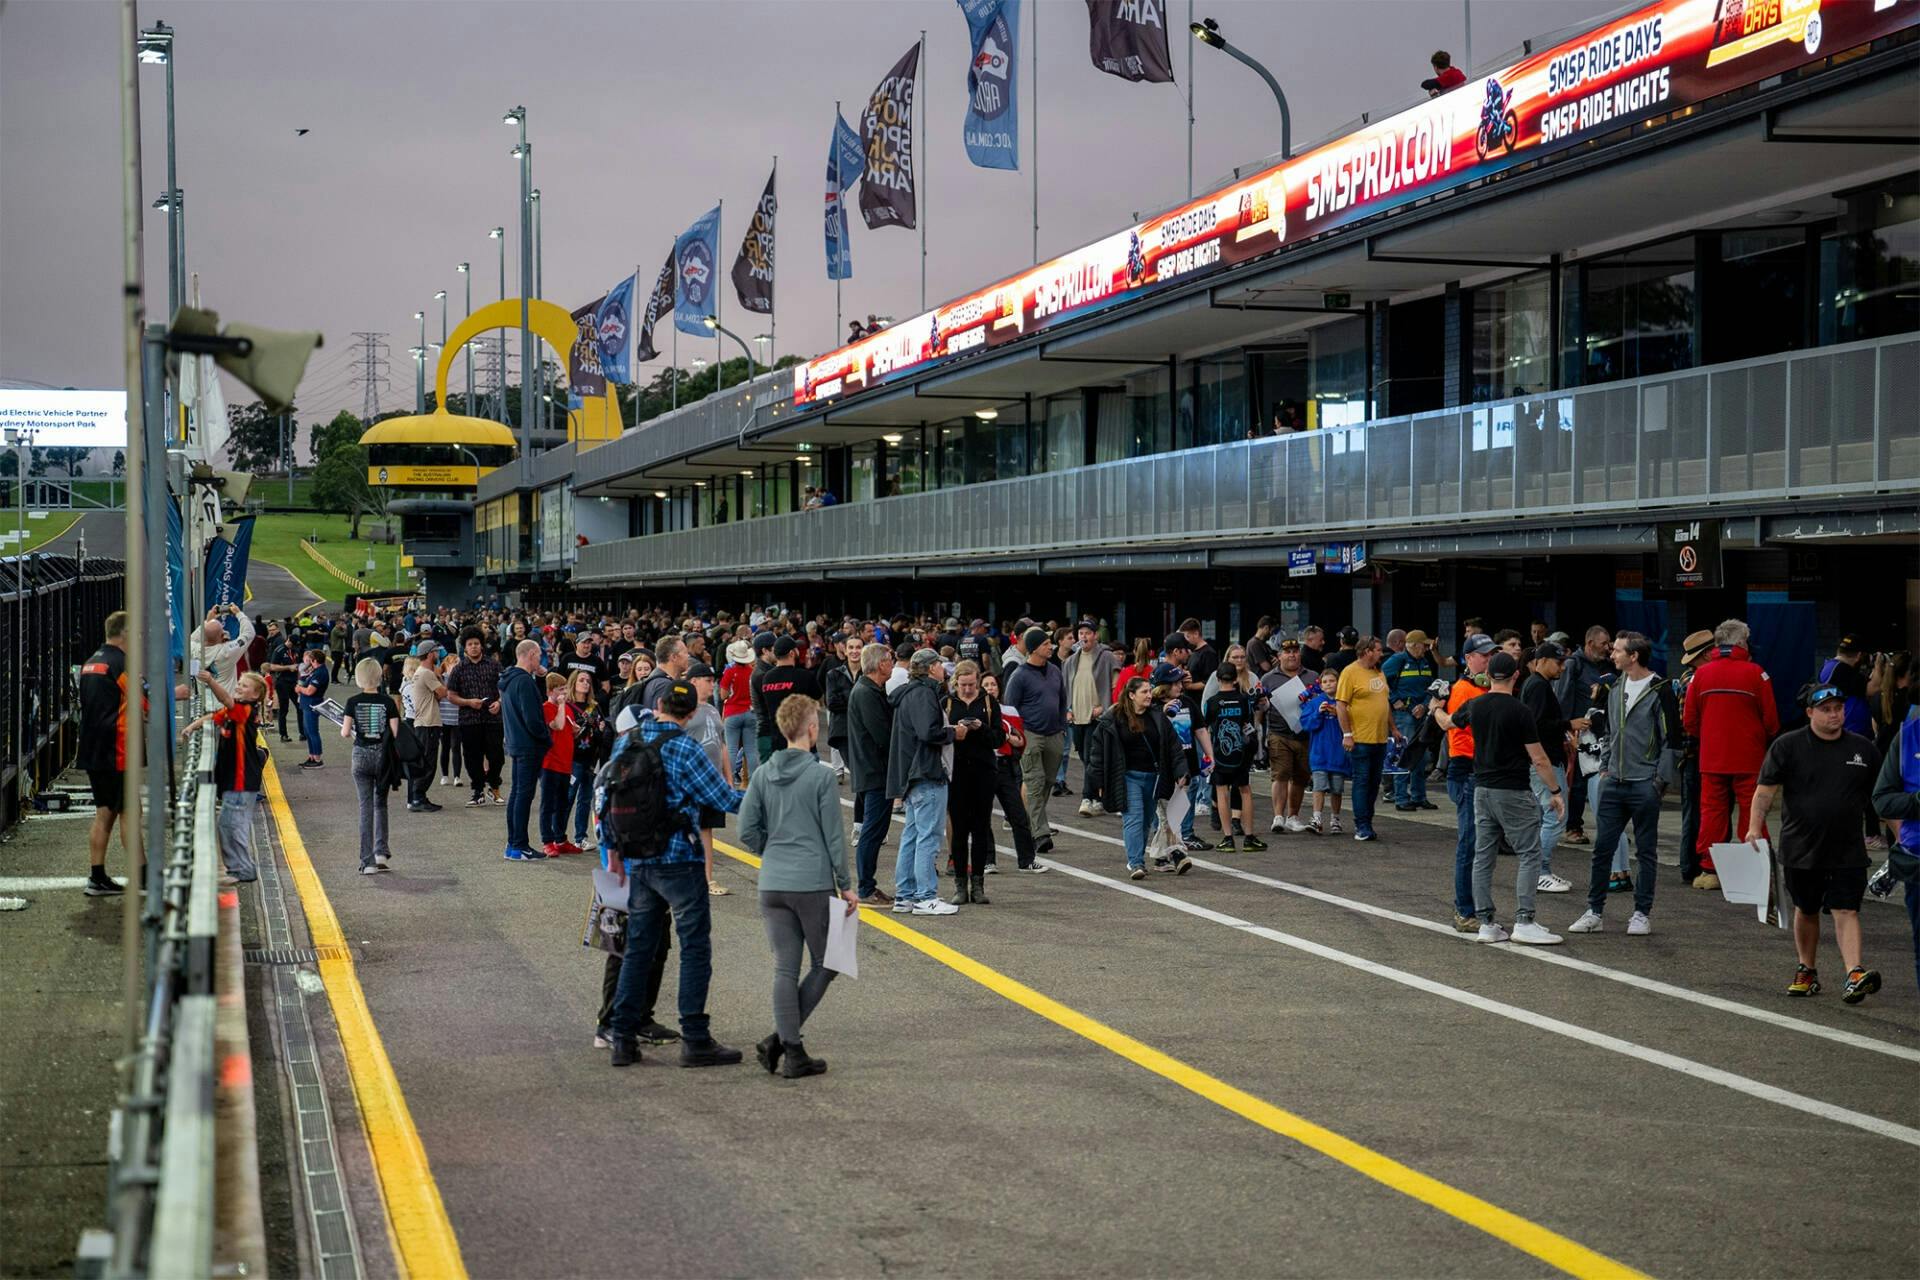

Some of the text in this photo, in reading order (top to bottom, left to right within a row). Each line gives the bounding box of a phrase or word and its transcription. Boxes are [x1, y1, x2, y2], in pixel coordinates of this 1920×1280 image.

[1744, 3, 1778, 35] DAYS
[1549, 17, 1662, 93] SMSP RIDE DAYS
[1540, 66, 1670, 144] SMSP RIDE NIGHTS
[1305, 110, 1454, 221] SMSPRD.COM
[1161, 216, 1181, 247] SMSP
[1182, 211, 1198, 238] RIDE
[1199, 204, 1217, 232] DAYS
[1157, 237, 1220, 281] SMSP RIDE NIGHTS
[1034, 263, 1113, 319] SMSPRD.COM
[0, 420, 25, 428] ydney
[27, 420, 75, 428] Motorsport
[10, 409, 41, 417] Electric
[43, 409, 73, 417] Vehicle
[1689, 521, 1700, 540] 14
